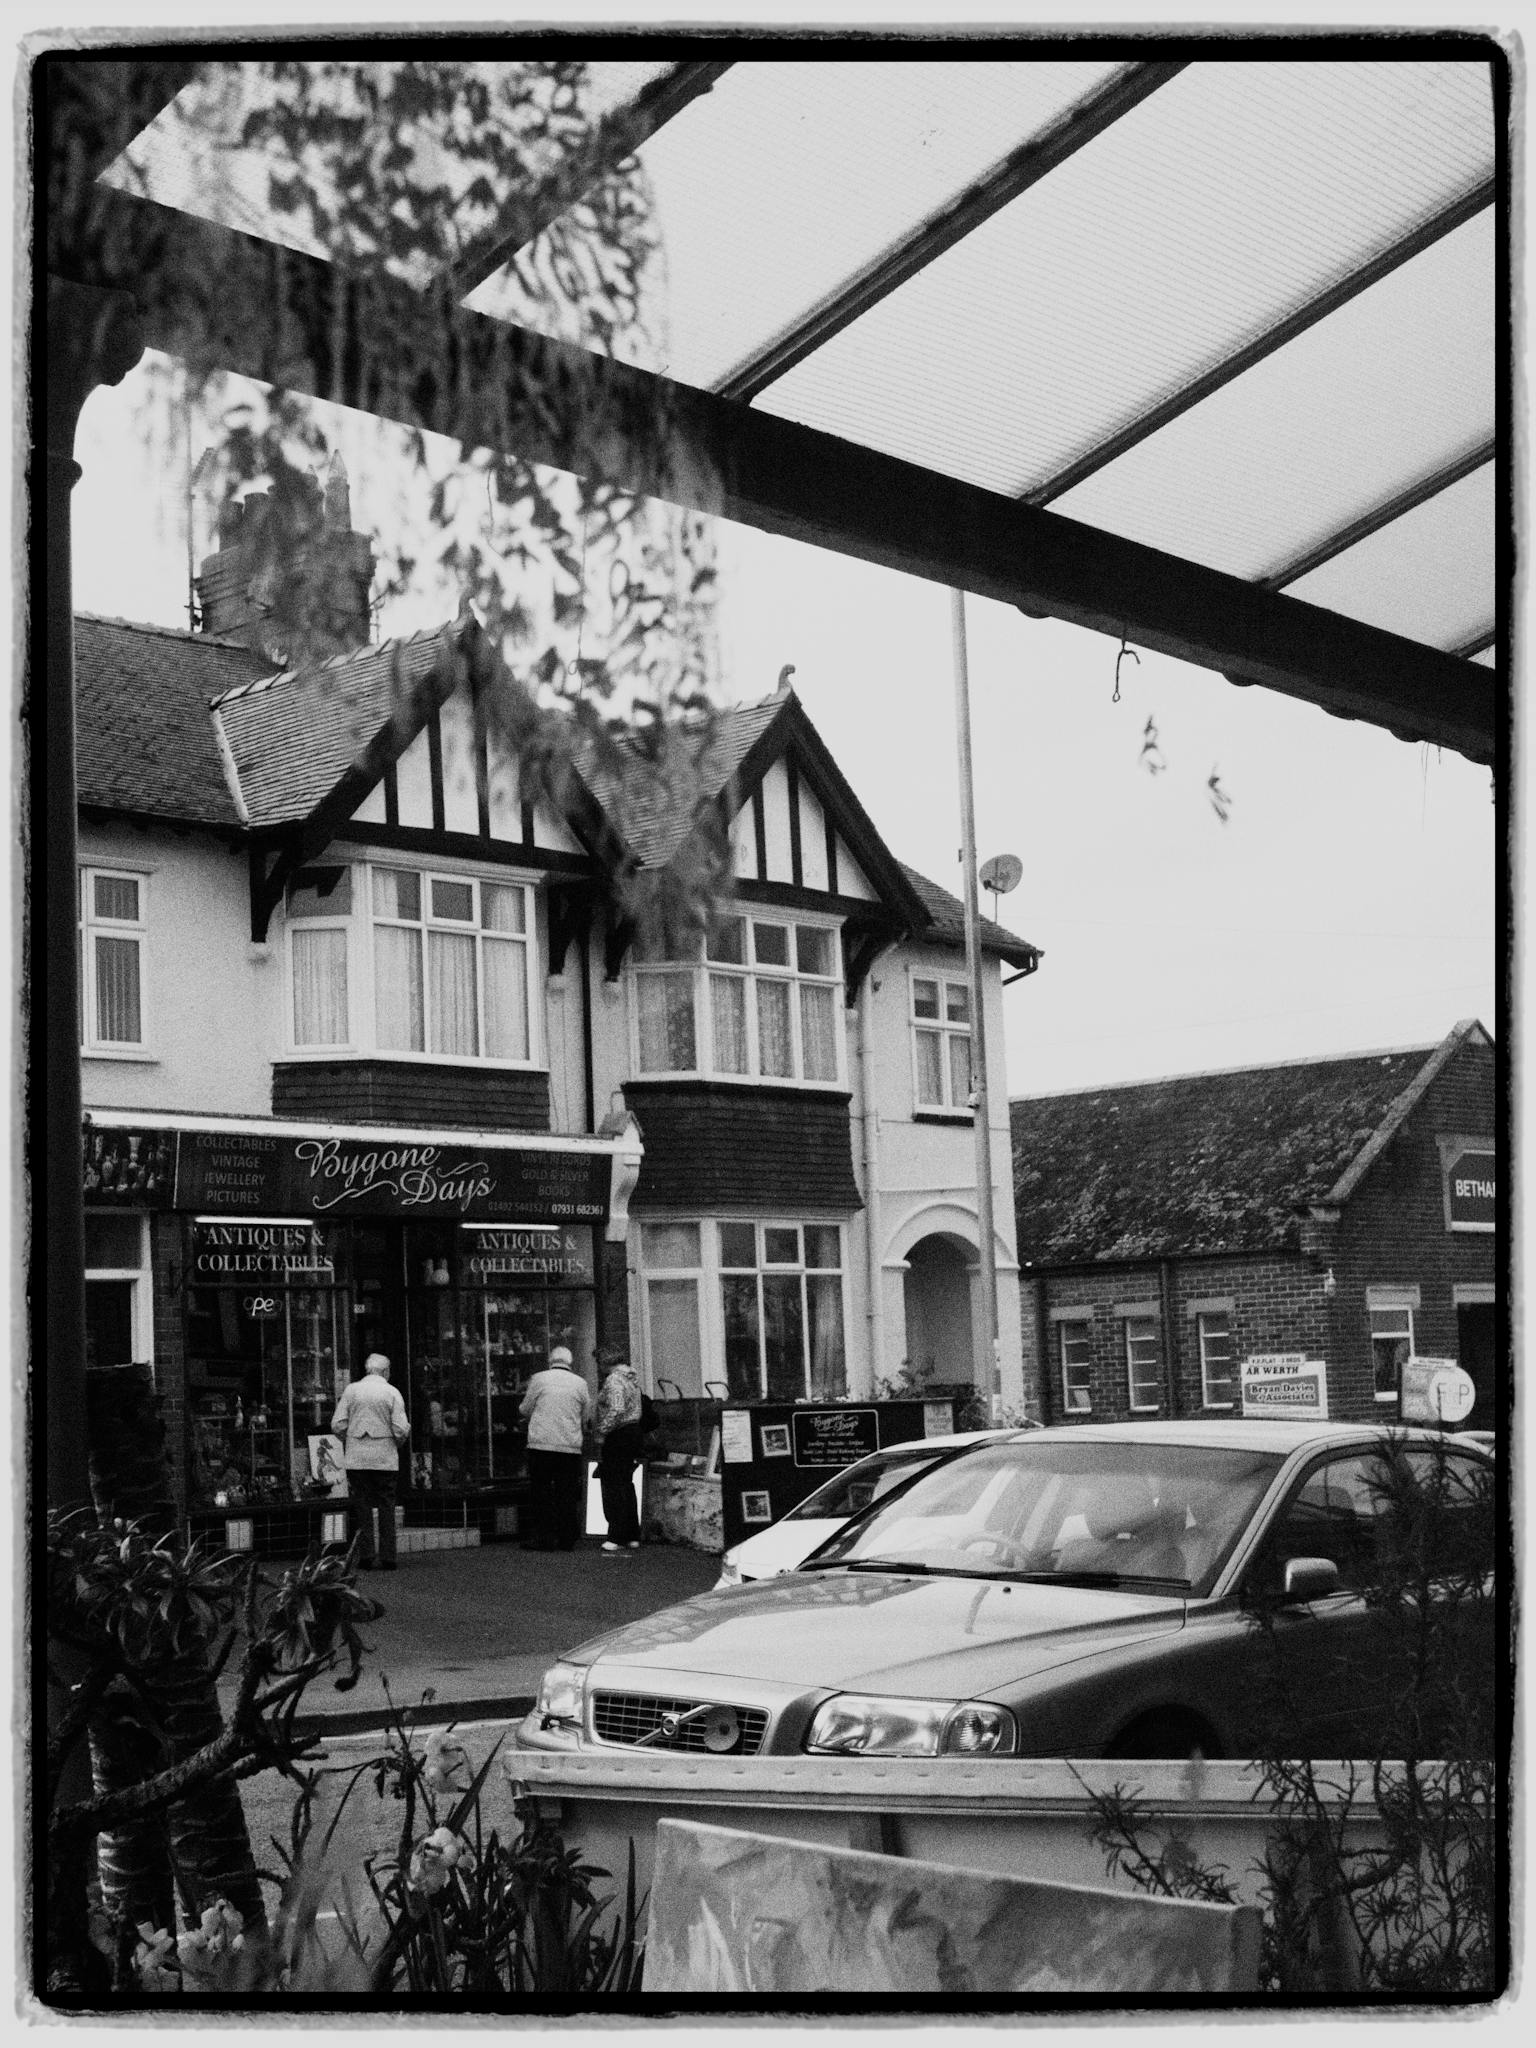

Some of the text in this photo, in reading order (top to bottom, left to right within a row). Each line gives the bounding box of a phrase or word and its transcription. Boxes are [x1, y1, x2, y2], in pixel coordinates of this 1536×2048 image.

[196, 1135, 278, 1152] COLLECTABLES
[210, 1154, 261, 1169] VINTAGE
[295, 1140, 441, 1189] Bygone
[203, 1171, 266, 1187] JEWELLERY
[521, 1168, 548, 1180] GOLD
[400, 1166, 497, 1211] Days
[538, 1185, 571, 1197] BOOKS
[206, 1189, 261, 1205] PICTURES
[551, 1203, 575, 1215] 07931
[206, 1227, 326, 1250] ANTIQUES &
[477, 1232, 577, 1254] ANTIQUES &
[197, 1253, 334, 1272] COLLECTABLES
[470, 1256, 584, 1273] COLLECTABLES
[1246, 1366, 1299, 1375] AR WERTH
[1251, 1383, 1314, 1394] Bryan Davies
[1266, 1393, 1315, 1402] Associates
